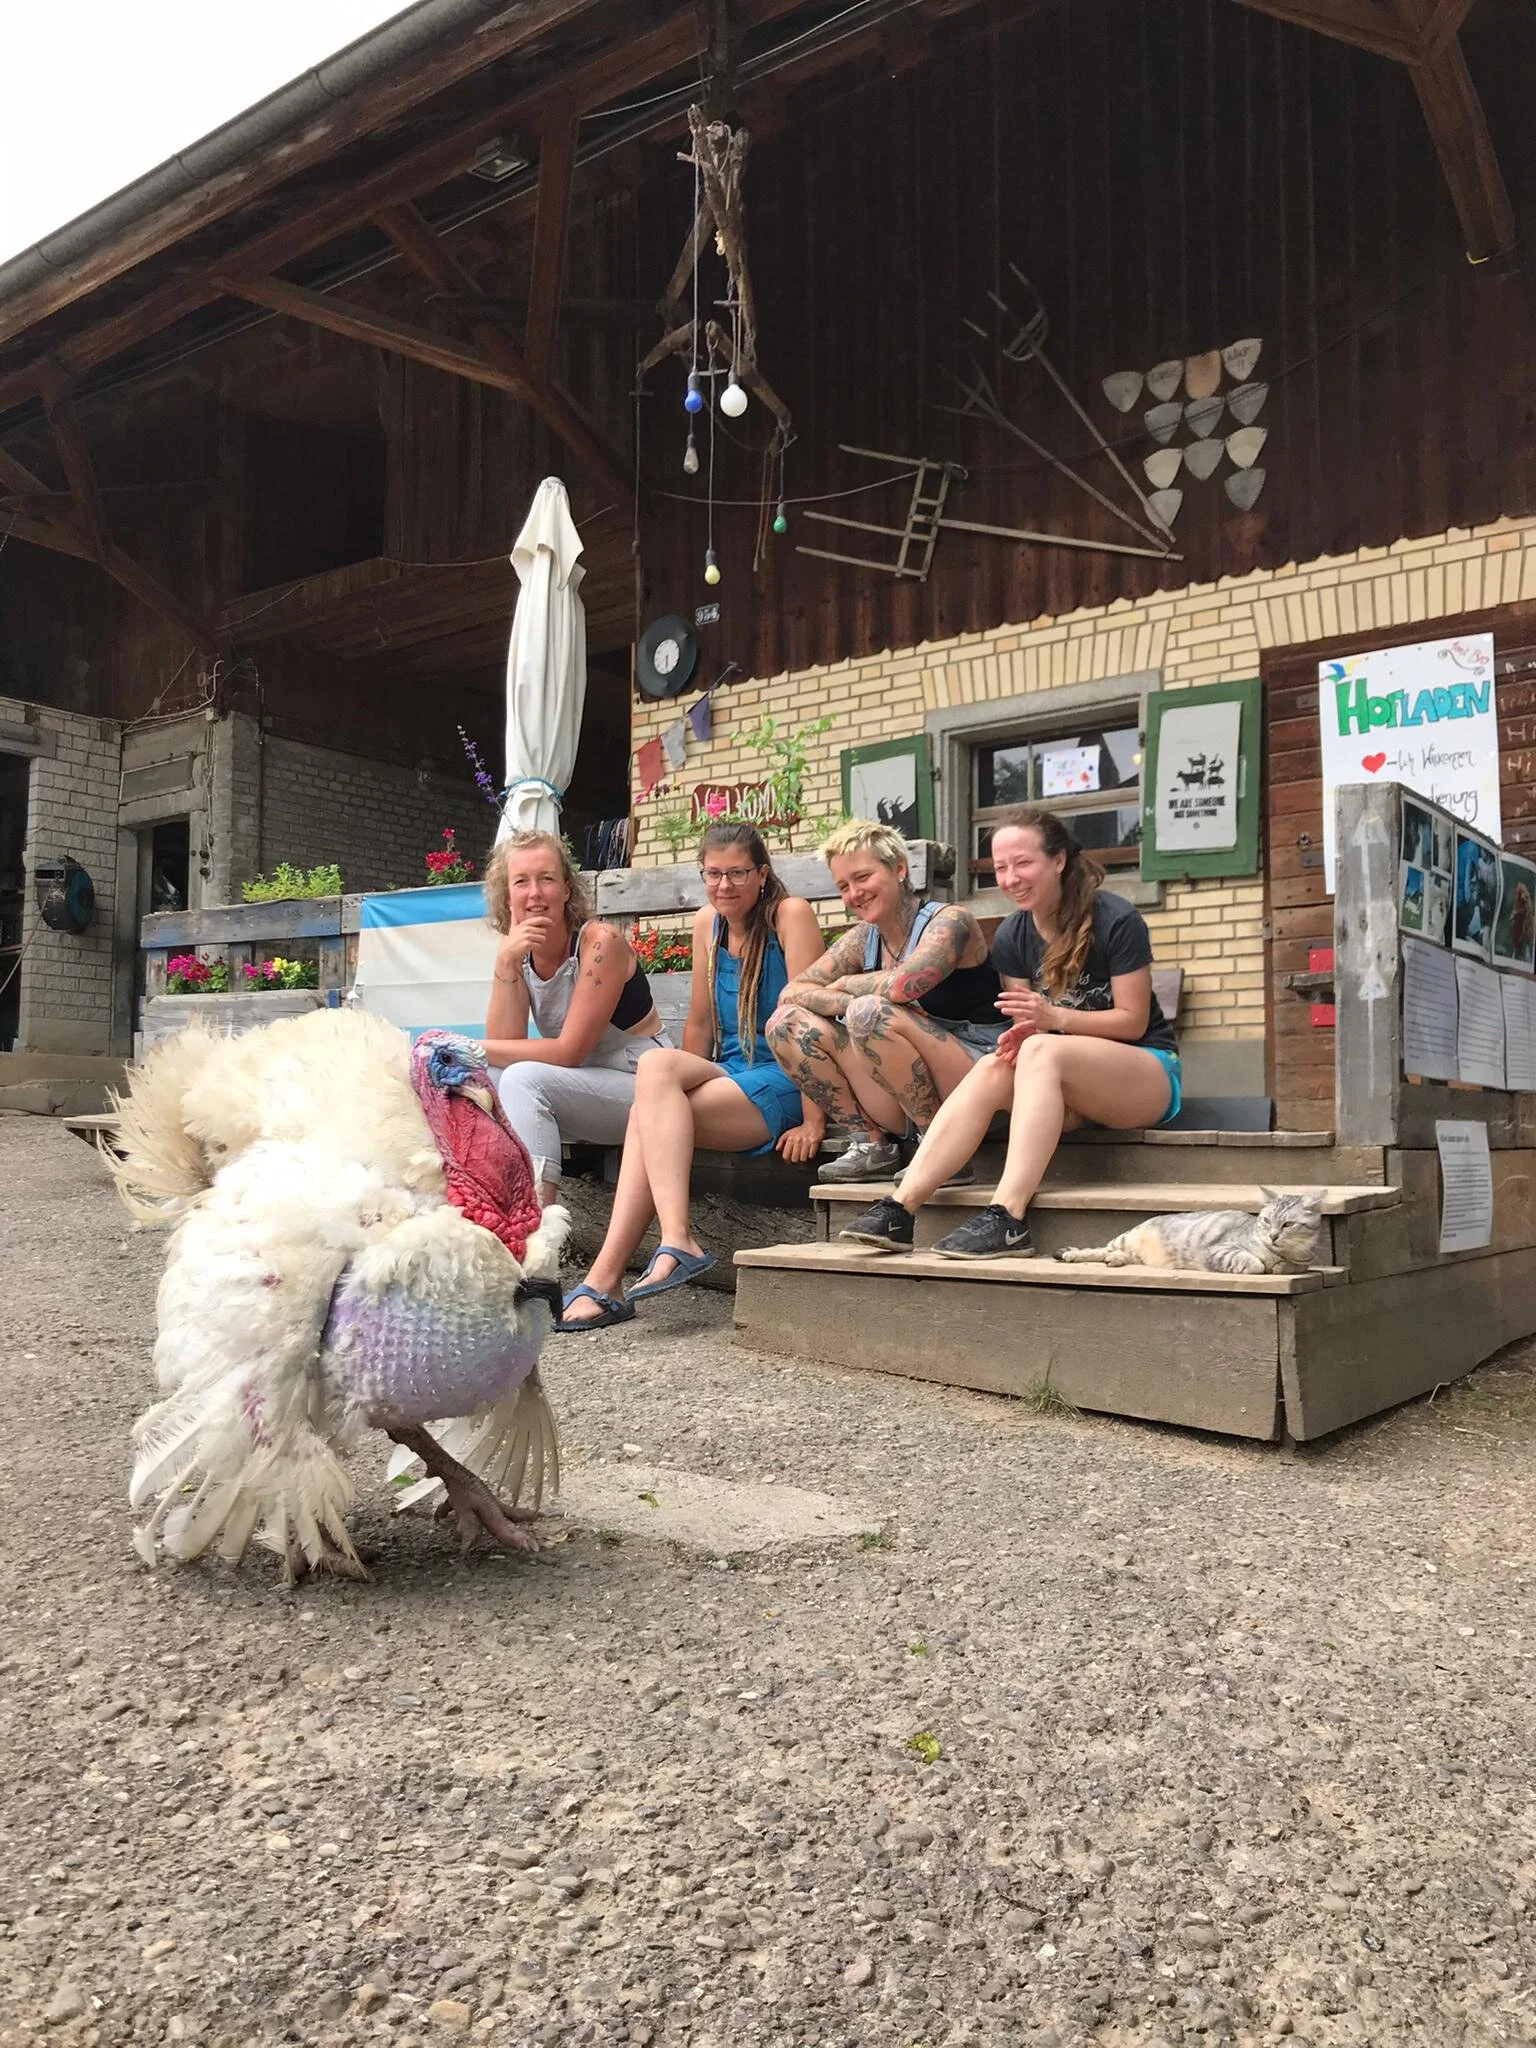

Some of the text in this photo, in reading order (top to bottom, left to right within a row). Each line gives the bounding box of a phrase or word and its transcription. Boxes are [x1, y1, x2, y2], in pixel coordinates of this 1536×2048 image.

[1335, 678, 1491, 737] HOFLADEN
[1180, 798, 1192, 808] ARE
[1194, 796, 1226, 807] SOMEONE
